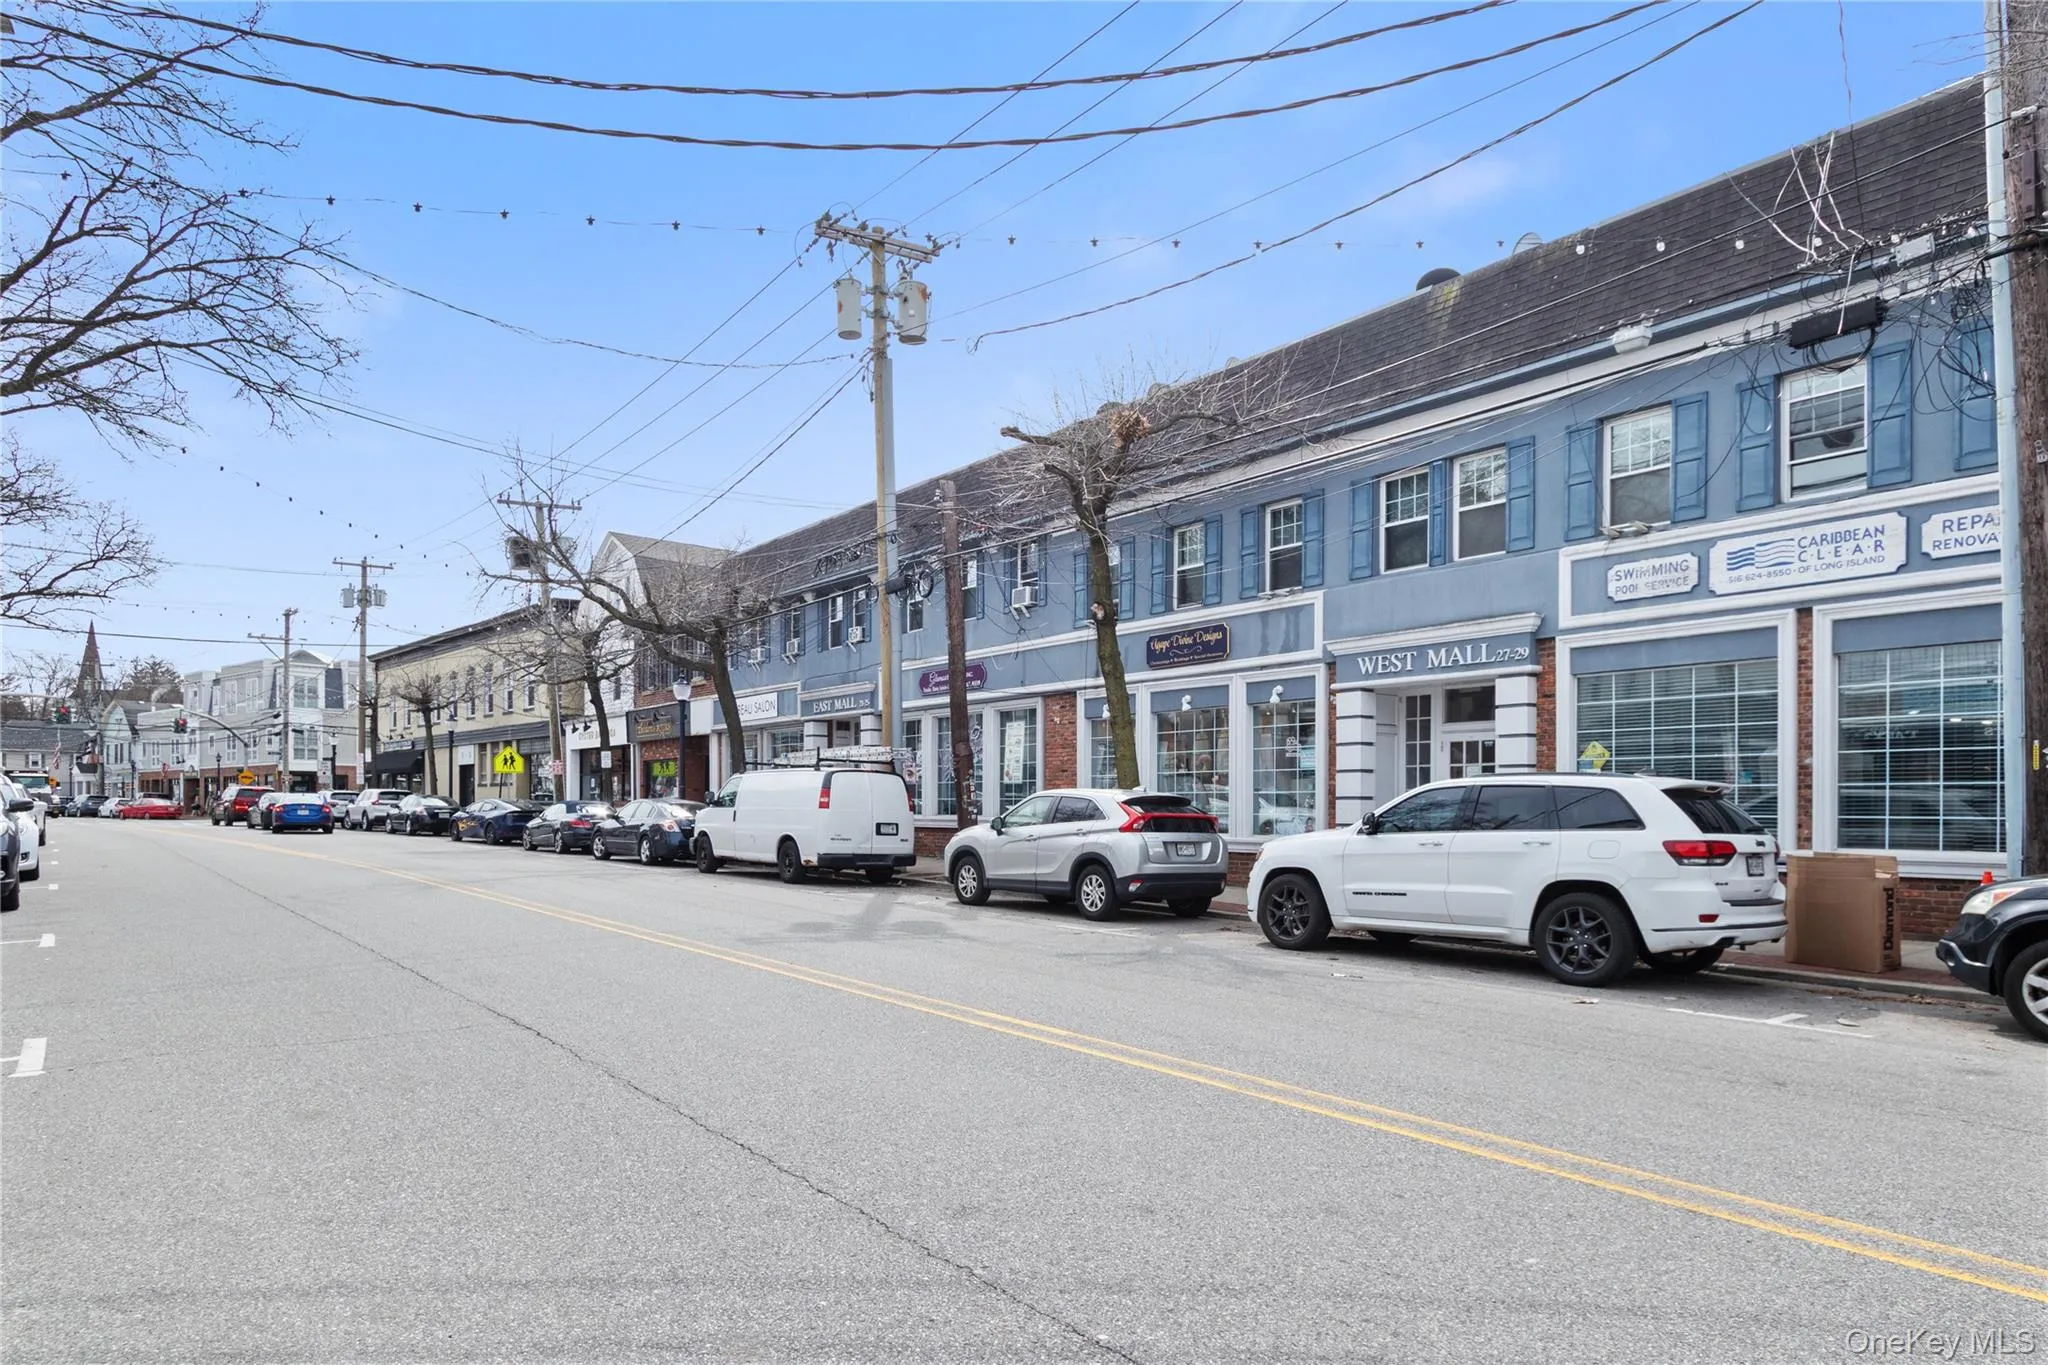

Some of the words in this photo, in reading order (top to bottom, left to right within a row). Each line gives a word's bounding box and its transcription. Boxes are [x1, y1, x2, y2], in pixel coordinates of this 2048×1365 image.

[1797, 524, 1885, 549] CARIBBEAN
[1932, 532, 2000, 551] RENOVA
[1614, 560, 1690, 582] SWIMMING
[1797, 565, 1811, 574] OF
[1814, 560, 1844, 572] LONG
[1846, 555, 1885, 568] ISLAND
[1357, 651, 1417, 676] WEST
[1427, 642, 1497, 669] MALL
[1495, 646, 1530, 663] 27-29
[753, 699, 776, 714] SALON
[813, 699, 833, 713] EAST
[834, 696, 857, 710] MALL
[1882, 887, 1894, 951] Diamond
